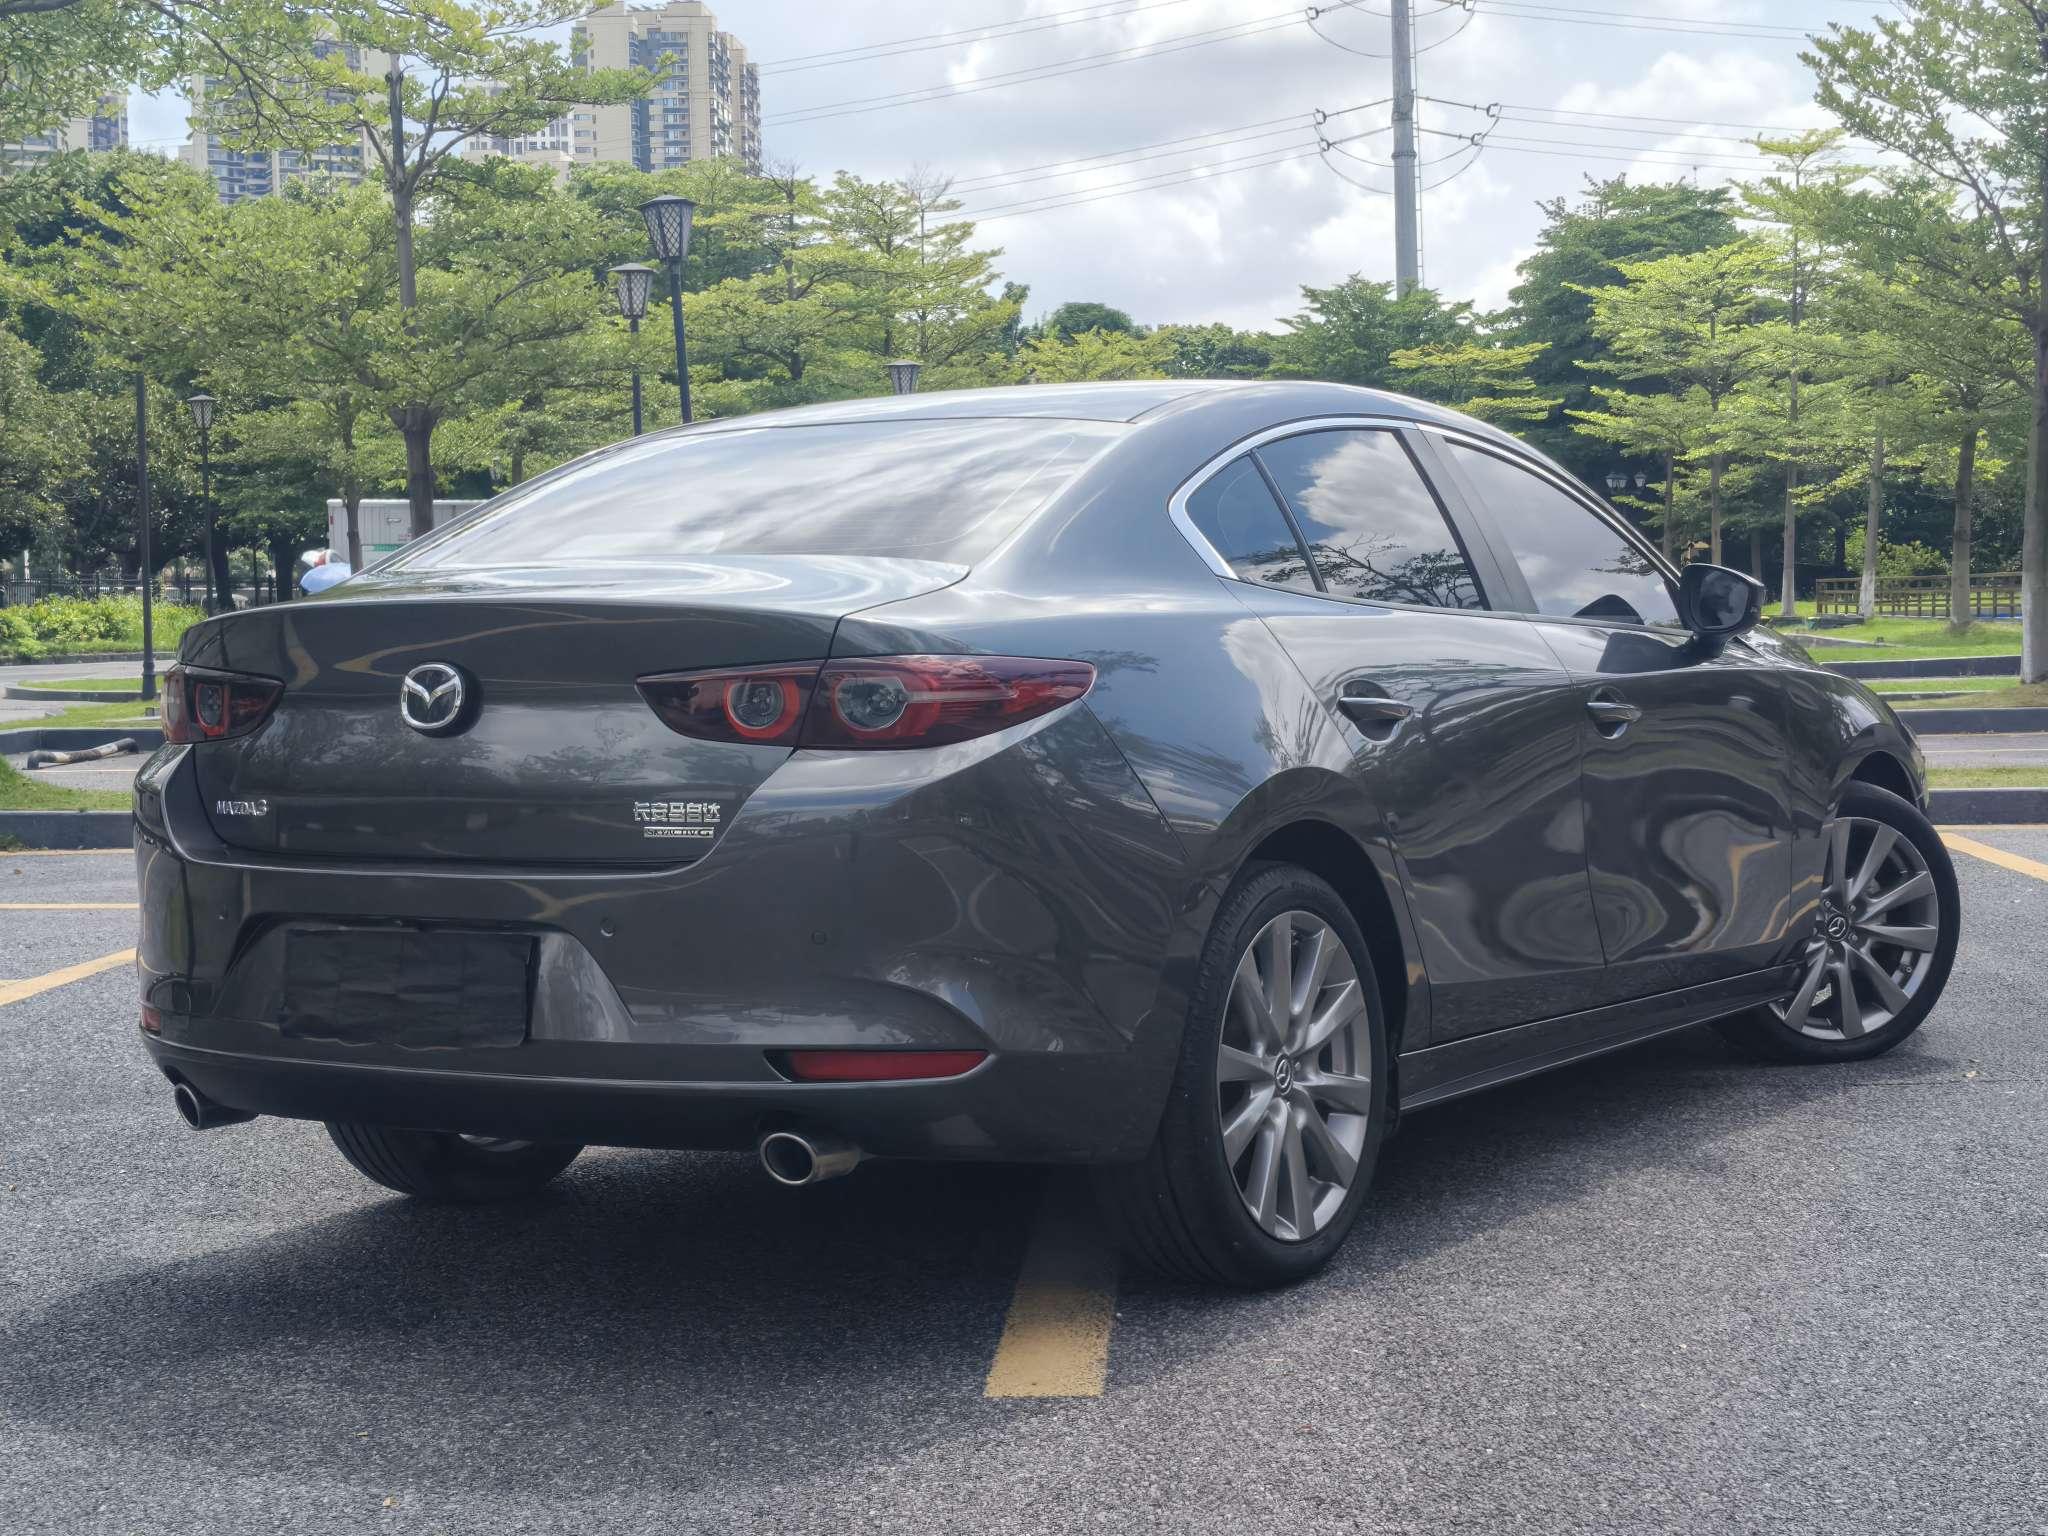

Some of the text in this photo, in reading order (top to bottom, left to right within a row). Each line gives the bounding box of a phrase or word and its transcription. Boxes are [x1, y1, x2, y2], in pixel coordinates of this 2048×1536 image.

[216, 799, 267, 816] MAZDA3
[633, 801, 721, 823] 长安马自达
